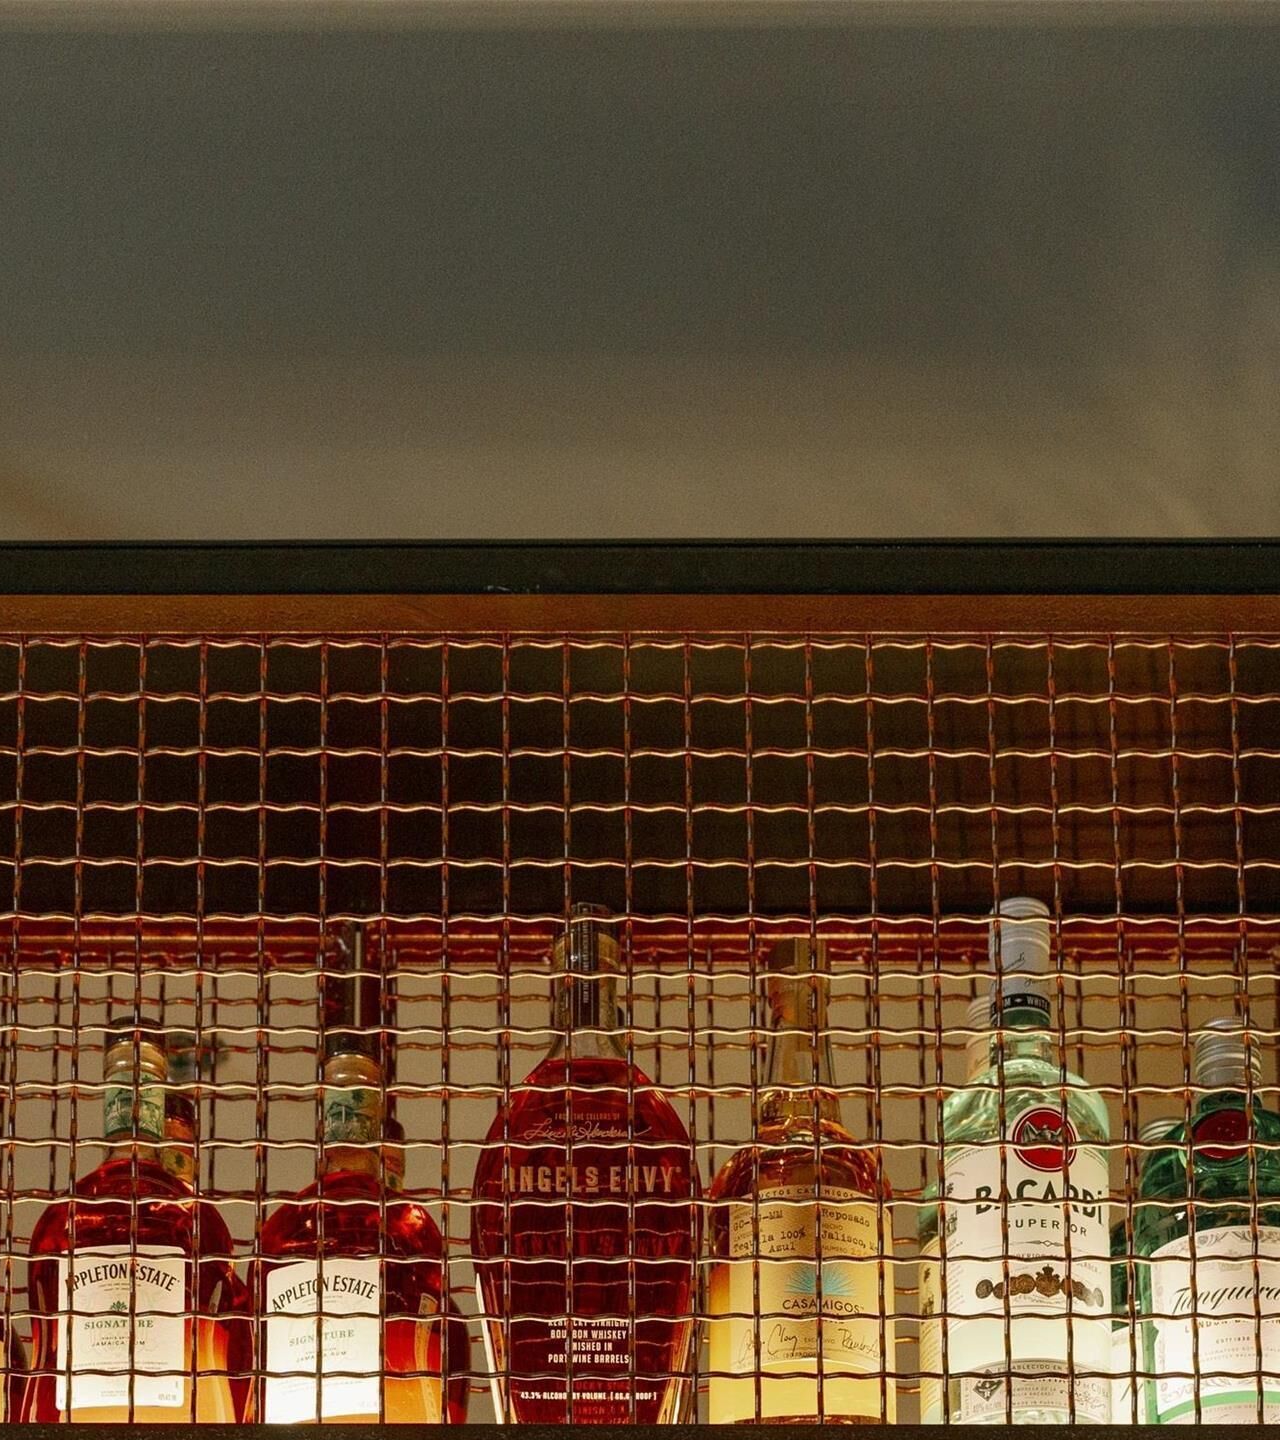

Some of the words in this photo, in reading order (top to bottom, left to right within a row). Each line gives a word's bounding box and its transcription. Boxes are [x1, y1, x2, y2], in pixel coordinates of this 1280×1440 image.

[797, 1187, 854, 1199] CASMIGOS
[822, 1207, 870, 1228] Reposado
[333, 1275, 378, 1300] ESTATE
[84, 1319, 154, 1330] SIGNATRE
[289, 1329, 355, 1347] SIGNTURE
[550, 1330, 587, 1339] BOUBON
[591, 1330, 627, 1340] WHISKEY
[604, 1342, 613, 1351] IN
[548, 1354, 568, 1363] PORT
[572, 1354, 591, 1363] WINE
[594, 1354, 630, 1363] BARRELS
[542, 1391, 568, 1400] ALCOHO
